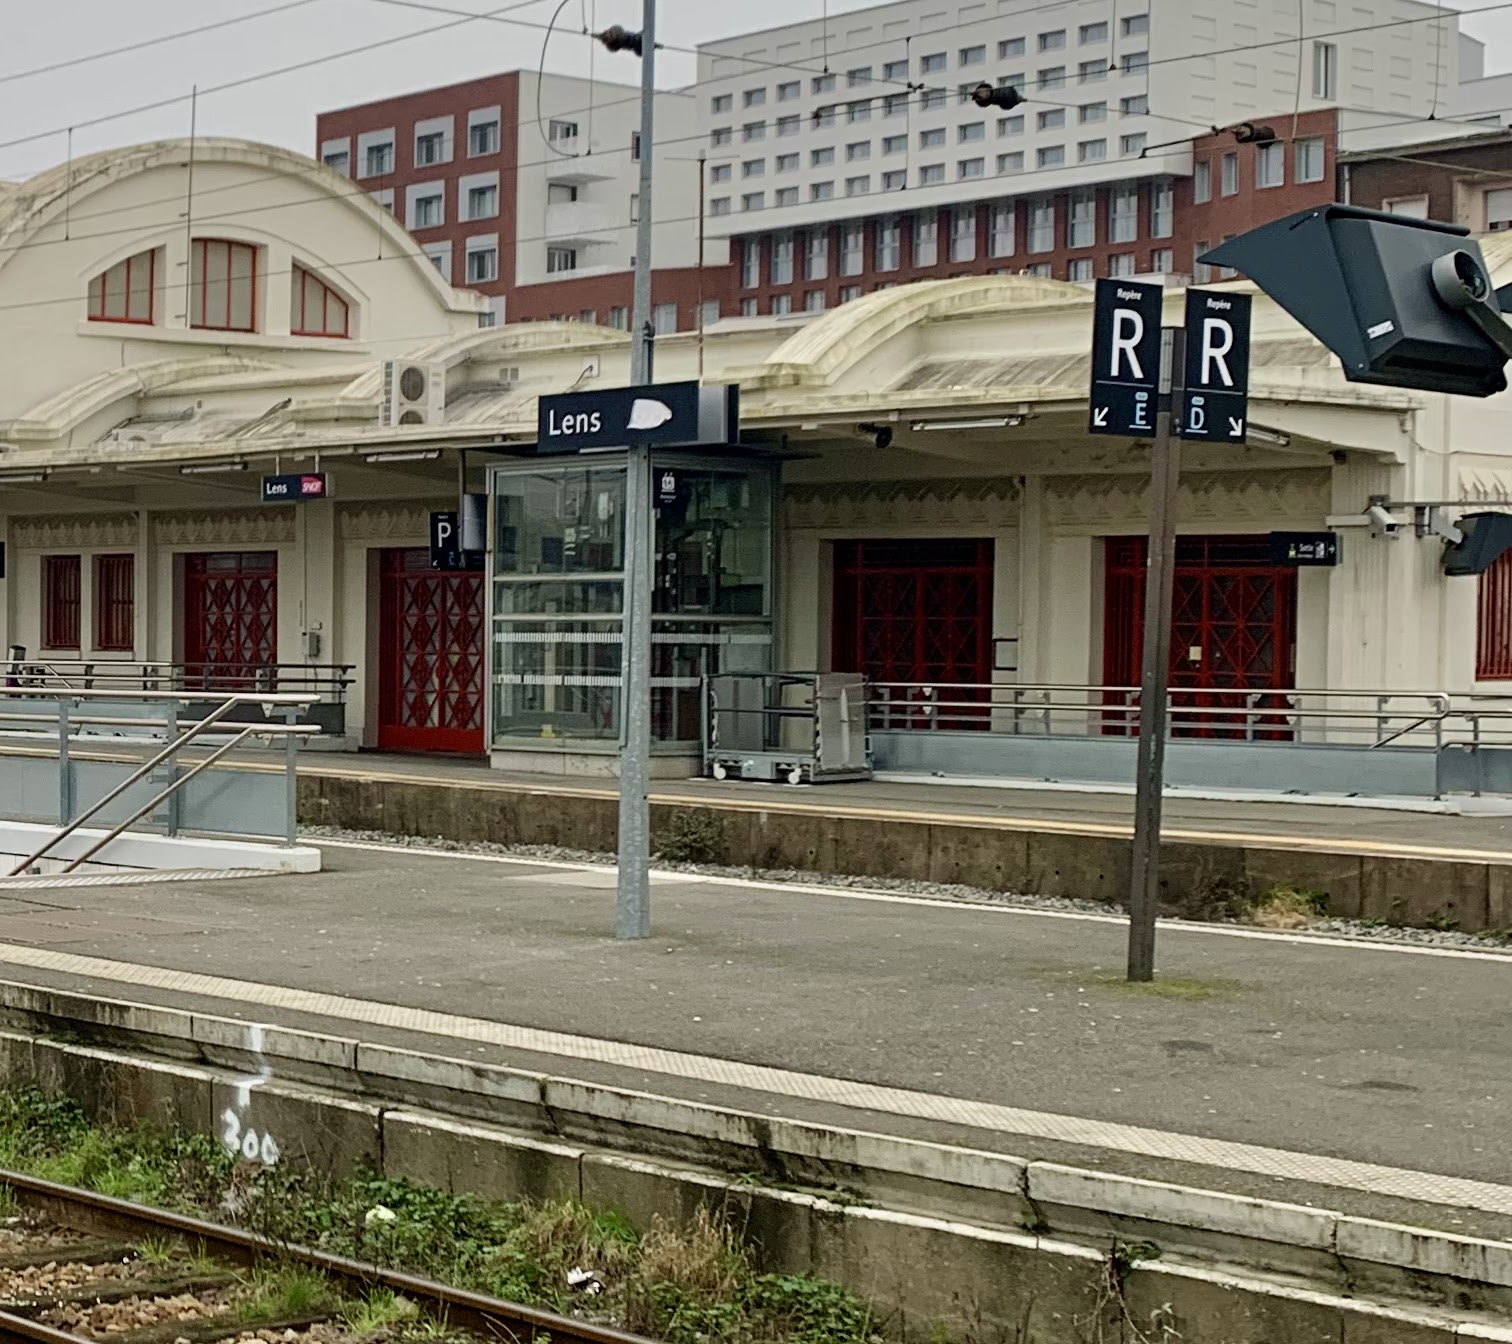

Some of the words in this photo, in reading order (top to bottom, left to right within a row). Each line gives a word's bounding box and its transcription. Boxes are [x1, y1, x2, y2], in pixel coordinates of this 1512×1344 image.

[1110, 308, 1144, 379] R
[1201, 318, 1234, 387] R
[549, 409, 601, 436] Lens
[1135, 403, 1147, 425] E
[1190, 407, 1205, 429] D
[266, 482, 288, 495] Lens
[438, 522, 451, 548] P
